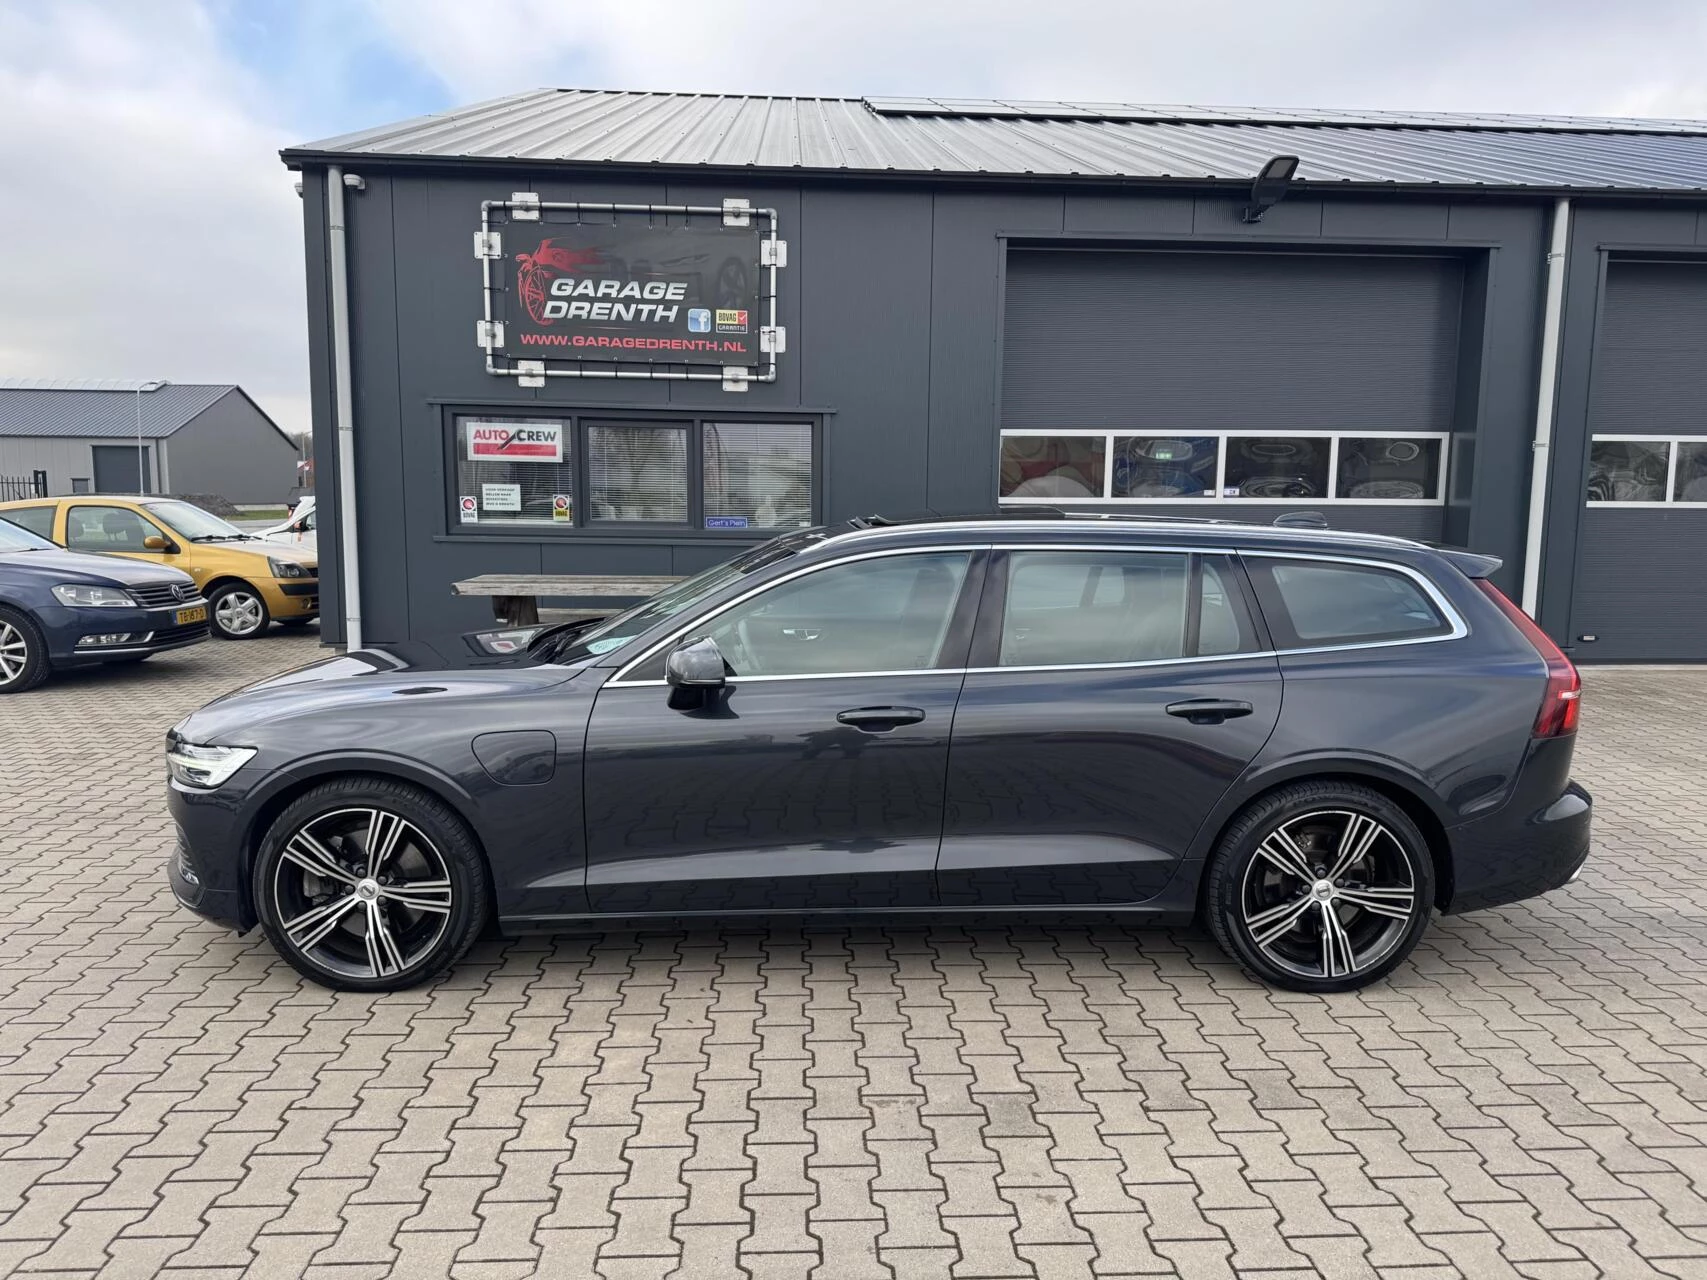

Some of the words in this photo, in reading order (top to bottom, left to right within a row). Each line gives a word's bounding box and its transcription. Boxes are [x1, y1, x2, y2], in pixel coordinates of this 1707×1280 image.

[550, 278, 687, 300] GARAGE
[543, 301, 679, 322] DRENTH
[718, 312, 737, 322] BOVAG
[520, 334, 746, 352] WWW.GARAGEDRENTH.NL
[473, 429, 510, 441] AUTO
[515, 430, 557, 442] CREW
